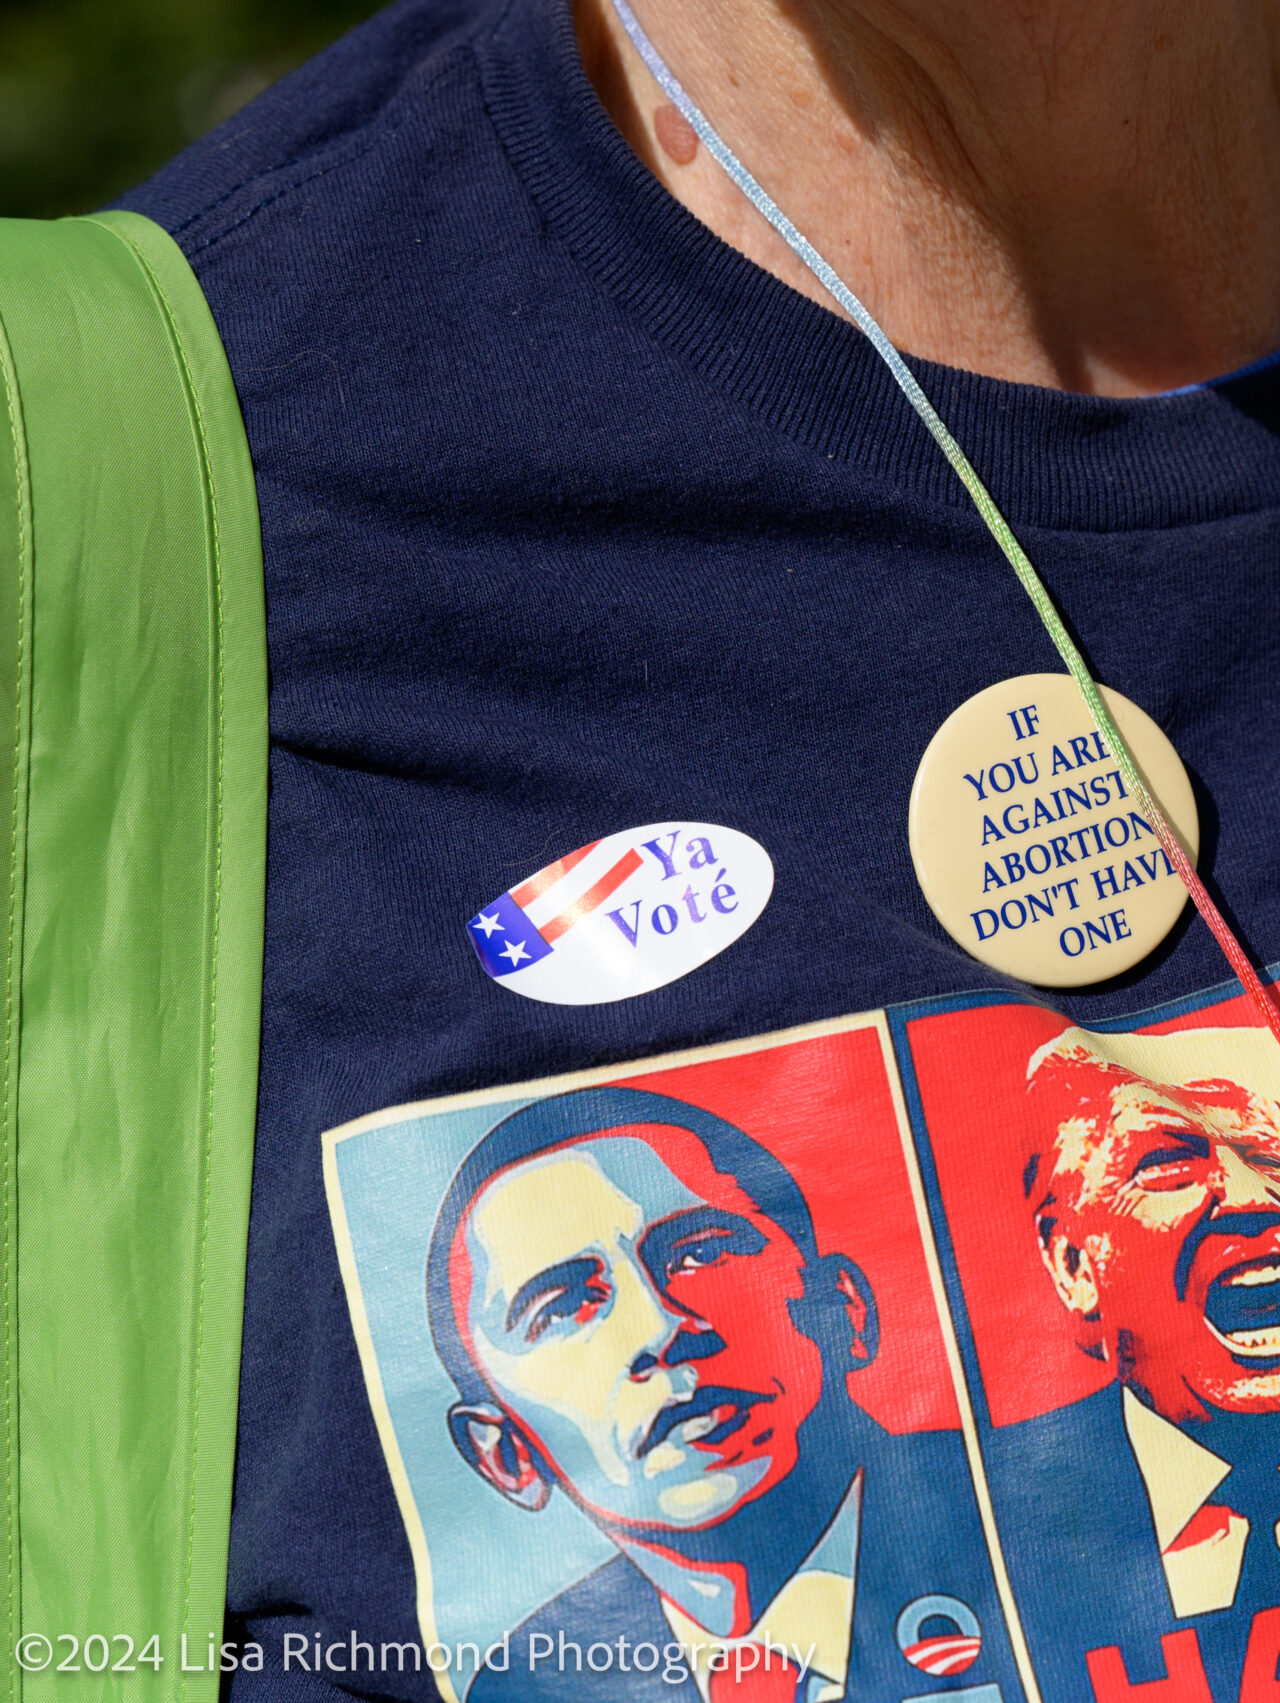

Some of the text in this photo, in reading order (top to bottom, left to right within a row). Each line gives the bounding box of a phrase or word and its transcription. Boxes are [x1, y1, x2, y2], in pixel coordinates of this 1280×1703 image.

[1007, 704, 1040, 741] IF
[963, 752, 1039, 802] YOU
[981, 770, 1129, 847] AGAINST
[640, 829, 720, 881] Ya
[981, 810, 1156, 894] ABORTION
[604, 867, 739, 948] Voté
[970, 878, 1080, 942] DON'T
[1059, 908, 1132, 958] ONE
